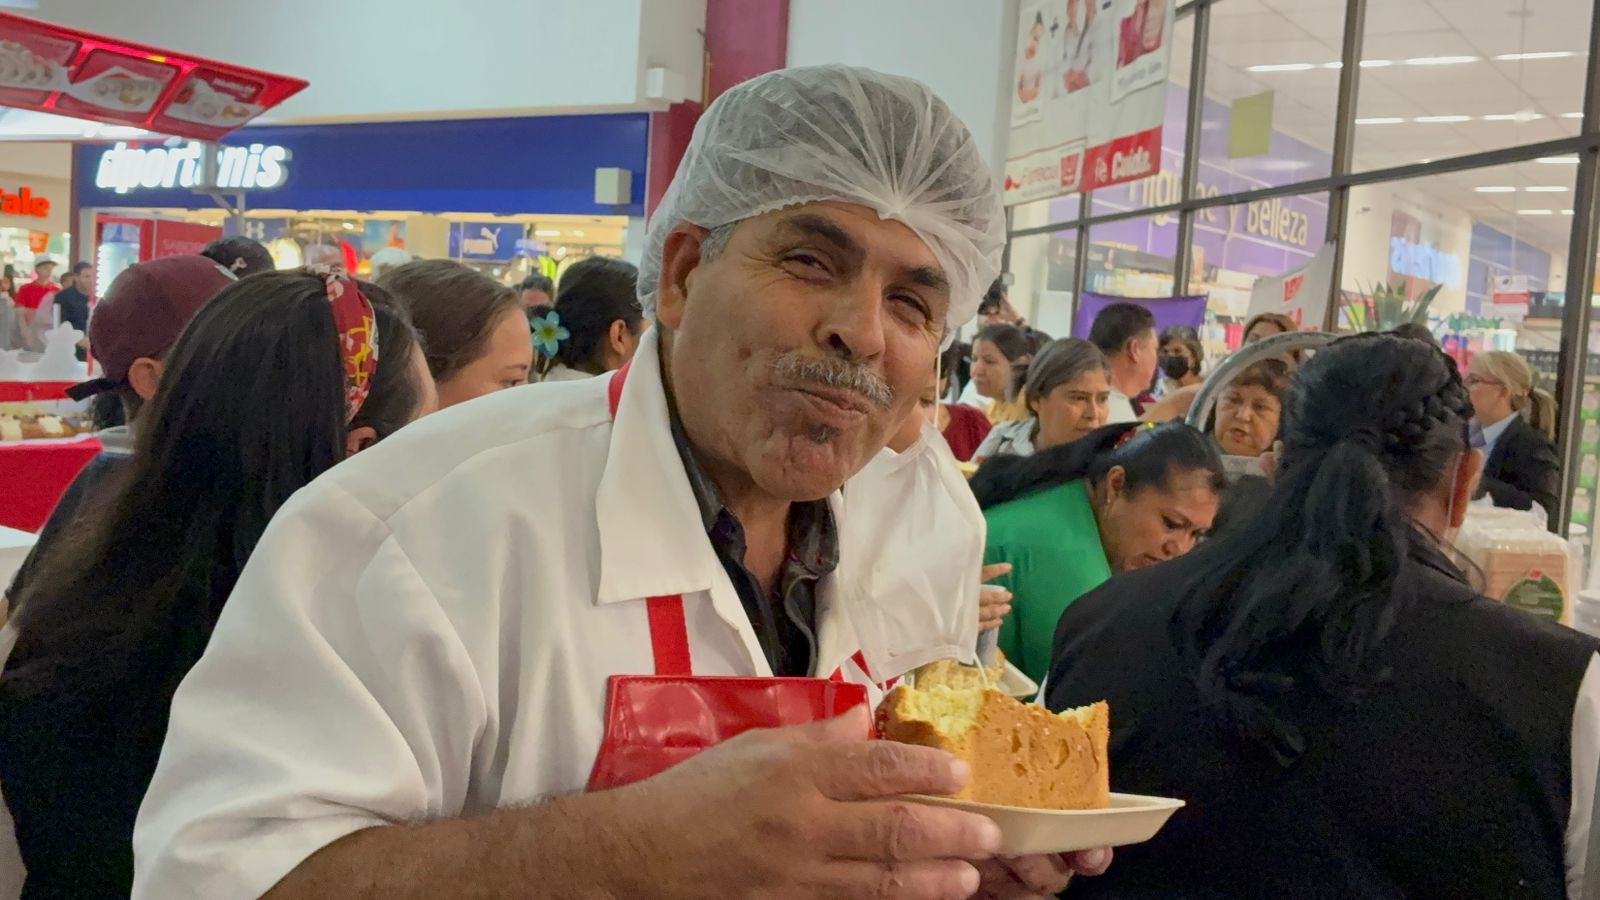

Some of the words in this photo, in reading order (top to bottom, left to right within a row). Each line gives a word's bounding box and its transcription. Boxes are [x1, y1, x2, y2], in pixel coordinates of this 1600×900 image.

[96, 141, 287, 194] dportnis
[0, 185, 50, 219] ale
[1246, 188, 1309, 246] Belleza
